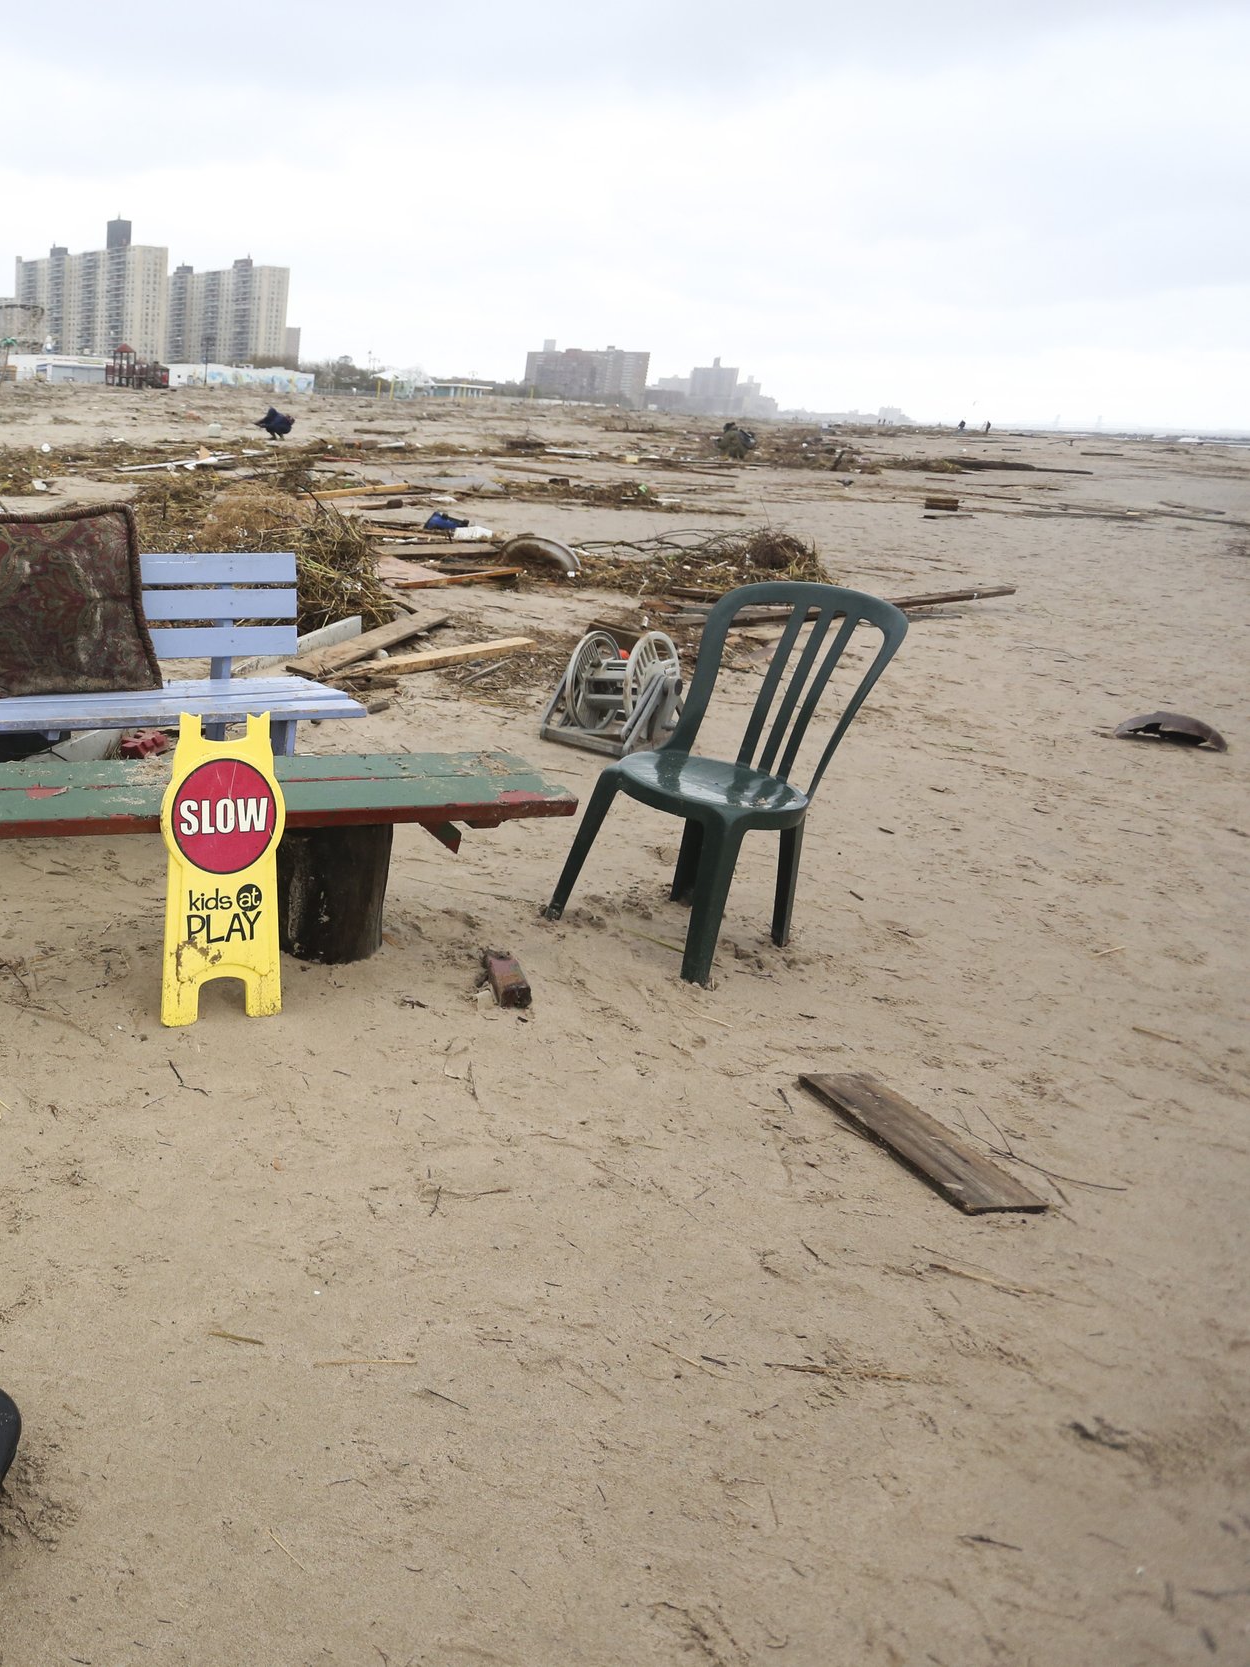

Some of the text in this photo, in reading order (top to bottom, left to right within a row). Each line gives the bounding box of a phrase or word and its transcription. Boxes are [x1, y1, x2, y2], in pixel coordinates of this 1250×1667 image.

[179, 797, 269, 836] SLOW
[189, 886, 261, 912] kids at
[187, 910, 262, 944] PLAY
